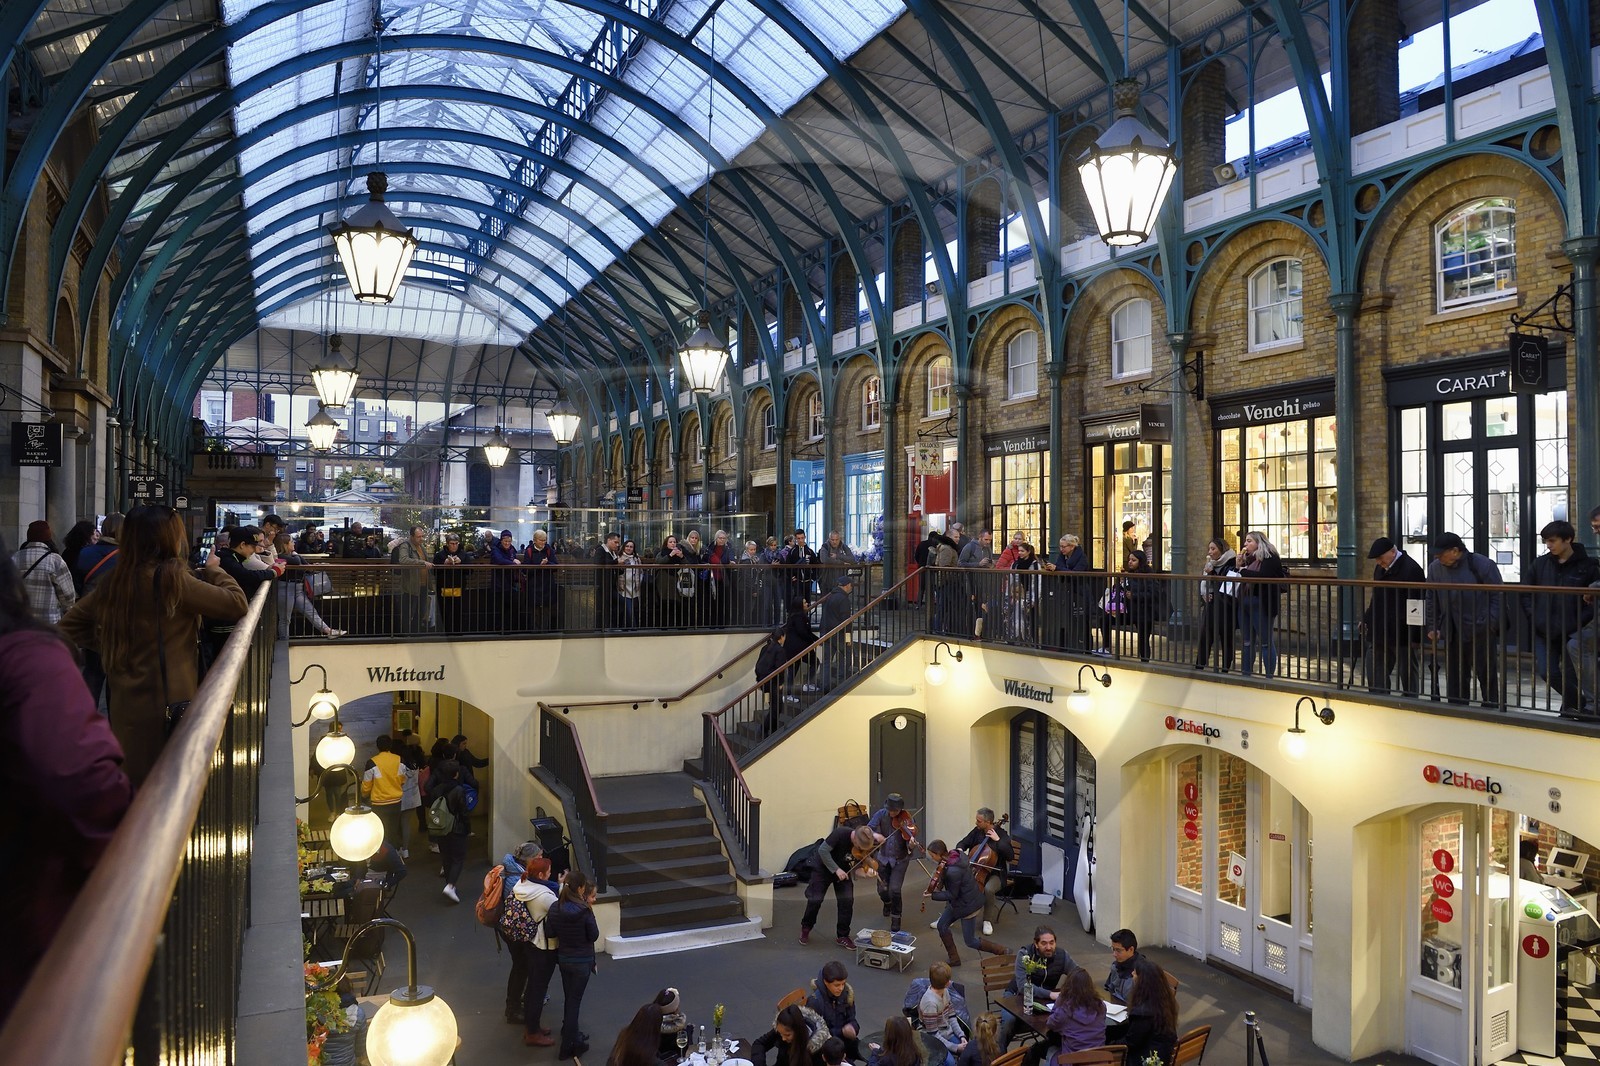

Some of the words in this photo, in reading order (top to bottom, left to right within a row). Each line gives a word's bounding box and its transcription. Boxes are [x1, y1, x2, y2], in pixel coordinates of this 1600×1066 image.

[1217, 412, 1241, 421] chocolate
[1243, 398, 1301, 421] Venchi
[1302, 401, 1321, 411] gelato
[1003, 437, 1036, 453] Venchi
[366, 665, 446, 683] Whittard
[1003, 678, 1054, 704] Whittard
[1176, 718, 1221, 738] 2theloo
[1442, 769, 1503, 795] 2thelo
[1185, 806, 1197, 817] WC
[1435, 879, 1453, 893] WC
[1432, 904, 1452, 917] ladies
